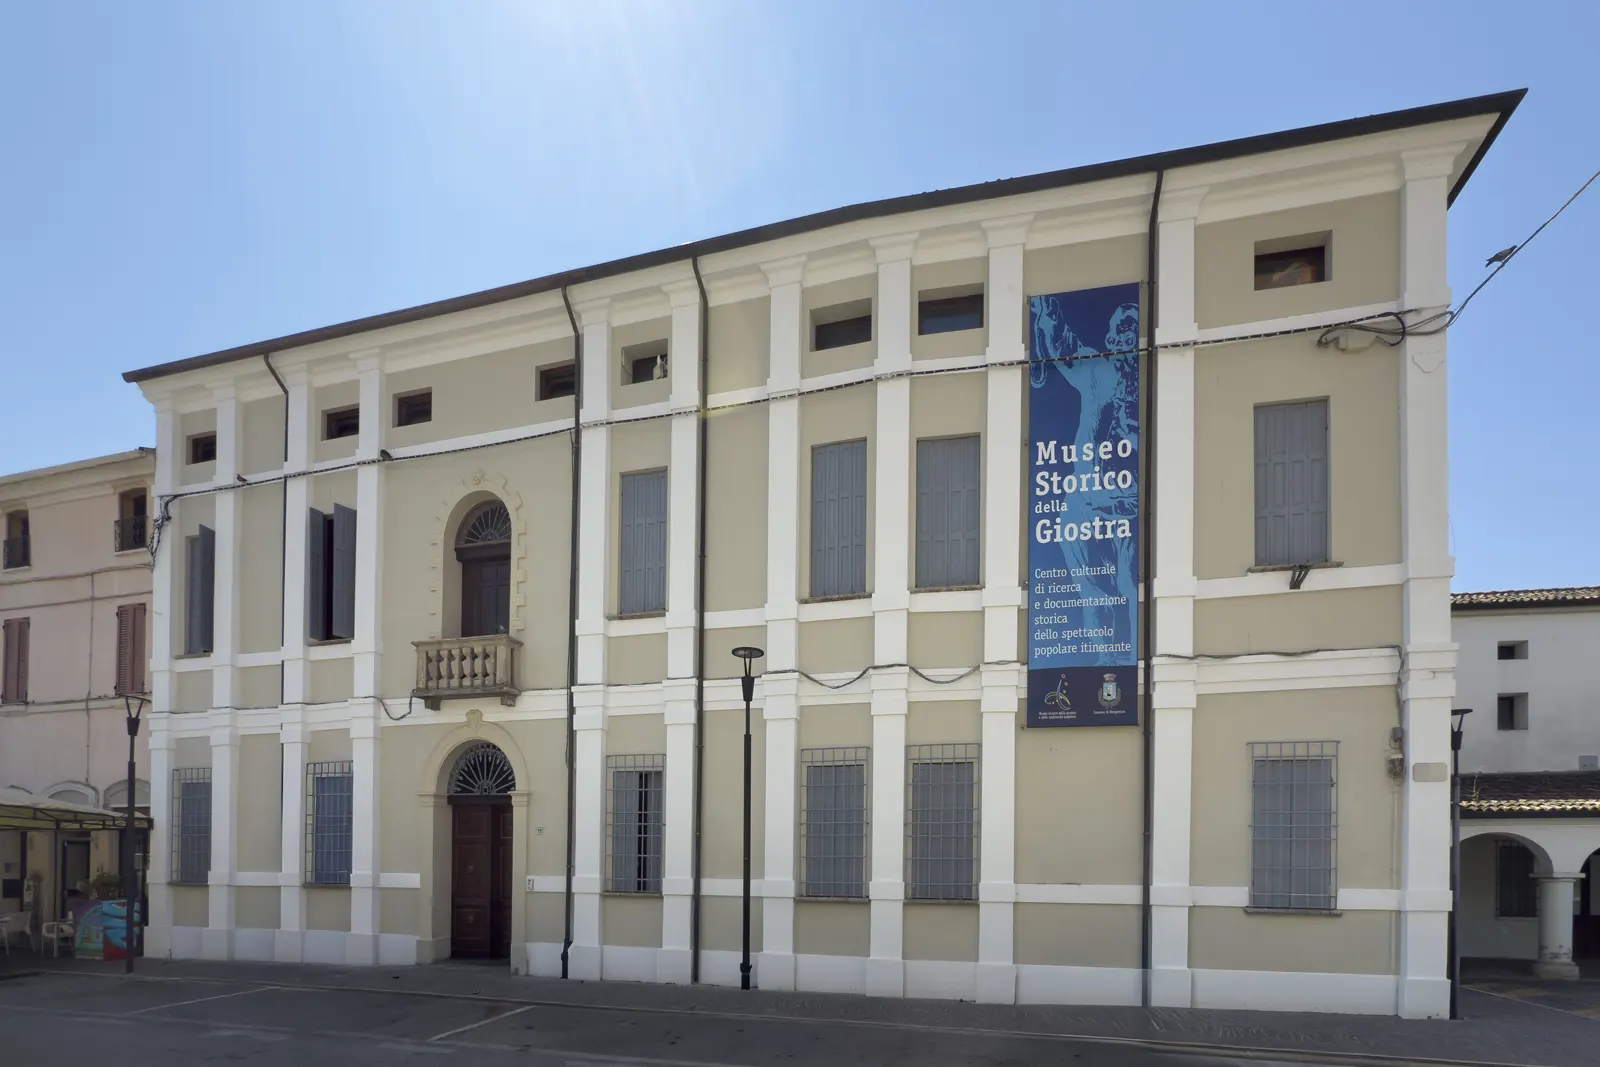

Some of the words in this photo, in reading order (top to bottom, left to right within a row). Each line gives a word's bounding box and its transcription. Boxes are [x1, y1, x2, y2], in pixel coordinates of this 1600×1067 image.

[1036, 439, 1132, 466] Museo
[1035, 466, 1132, 496] Storico
[1035, 500, 1068, 514] della
[1035, 517, 1132, 544] Giostra
[1035, 568, 1067, 579] Centro
[1070, 563, 1116, 577] culturale
[1035, 583, 1045, 594] di
[1048, 582, 1081, 594] ricerca
[1034, 601, 1041, 609] e
[1043, 595, 1127, 609] documentazione
[1034, 614, 1068, 625] storica
[1034, 629, 1058, 640] dello
[1061, 626, 1114, 641] spettacolo
[1034, 642, 1077, 659] popolare
[1080, 641, 1132, 653] itinerante
